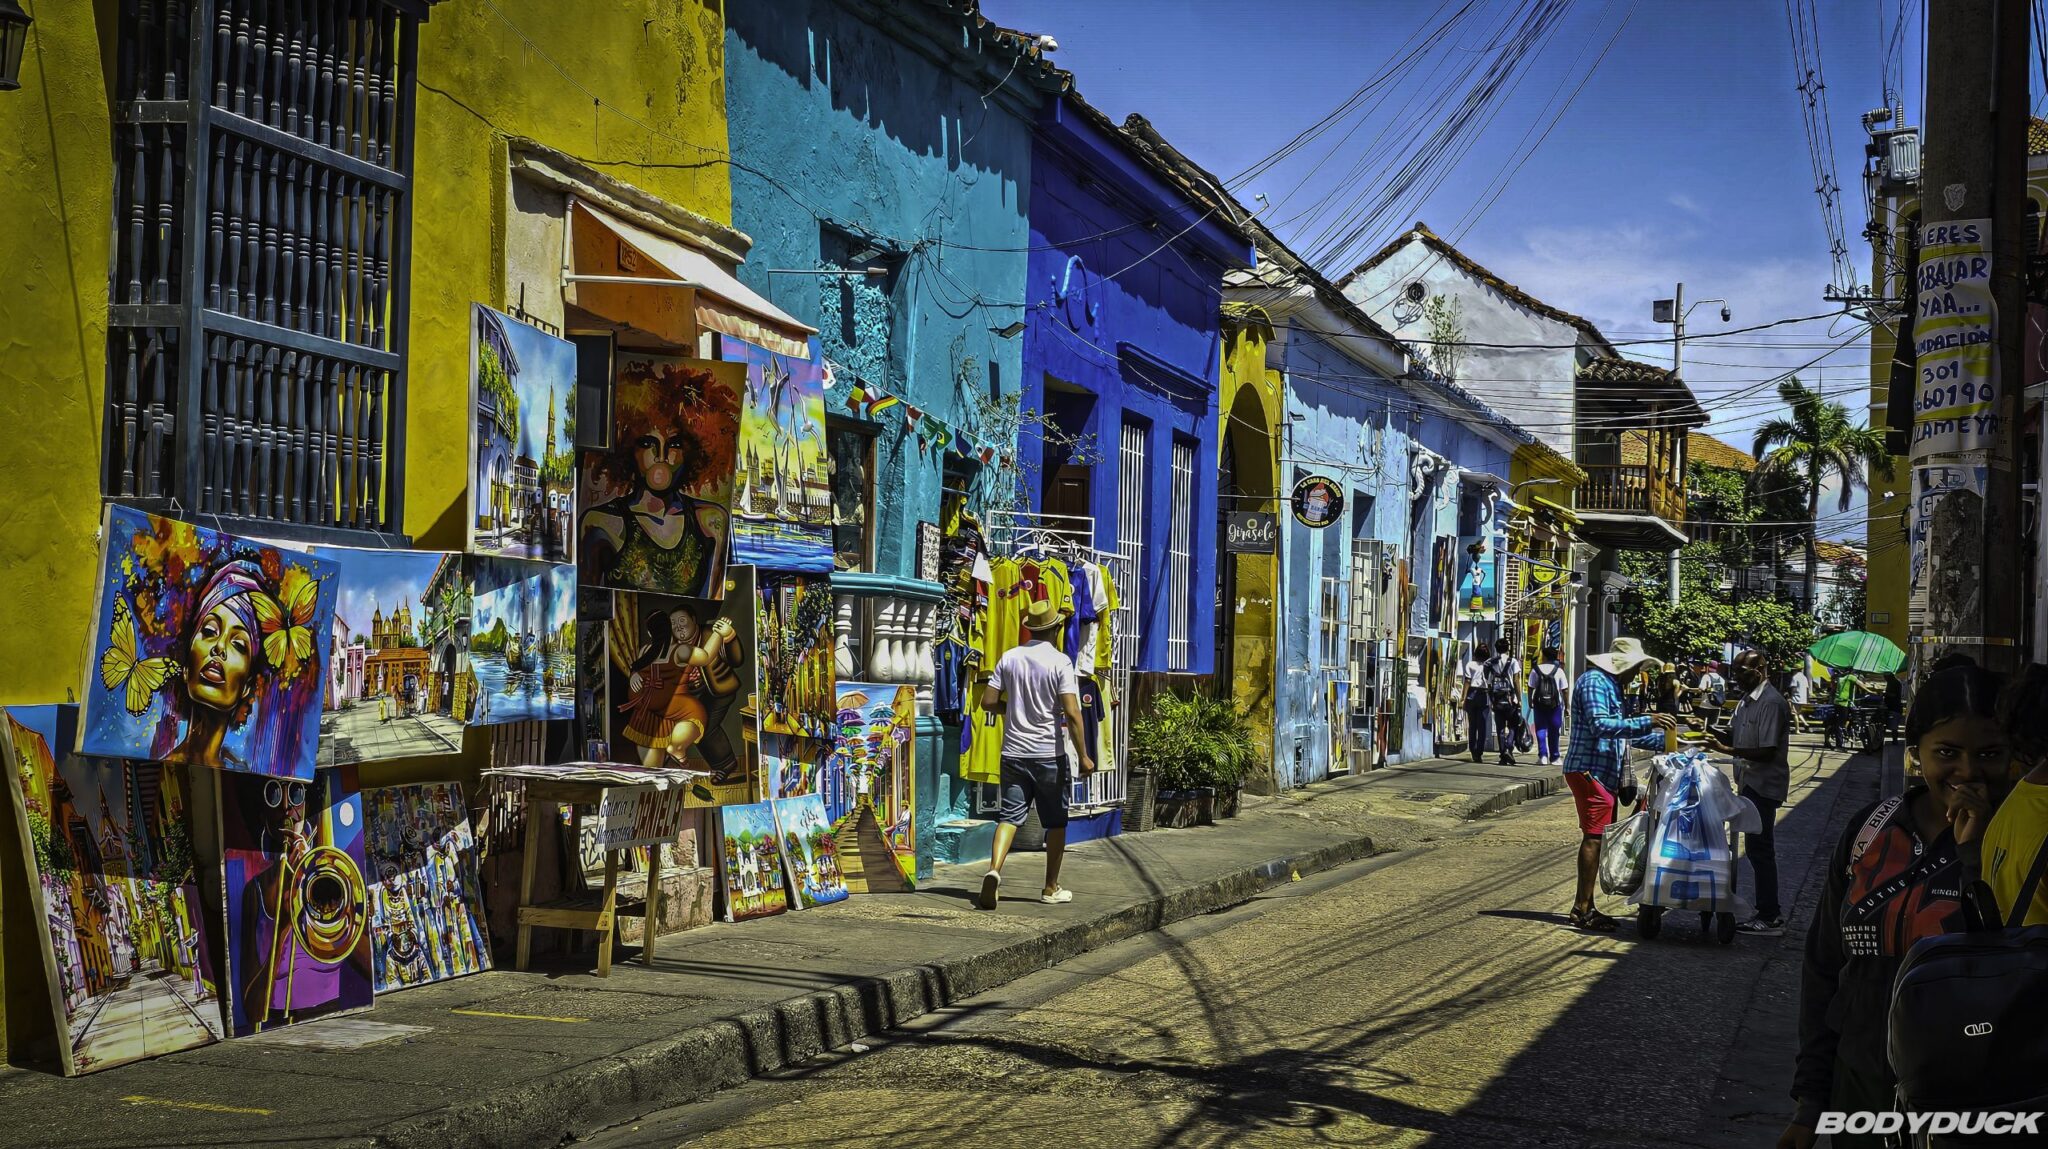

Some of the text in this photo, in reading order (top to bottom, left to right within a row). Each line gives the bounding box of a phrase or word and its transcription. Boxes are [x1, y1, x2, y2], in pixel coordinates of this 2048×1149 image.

[1922, 361, 1959, 384] 301
[634, 787, 684, 840] DANIELA
[1857, 856, 1948, 915] AUTHETIC
